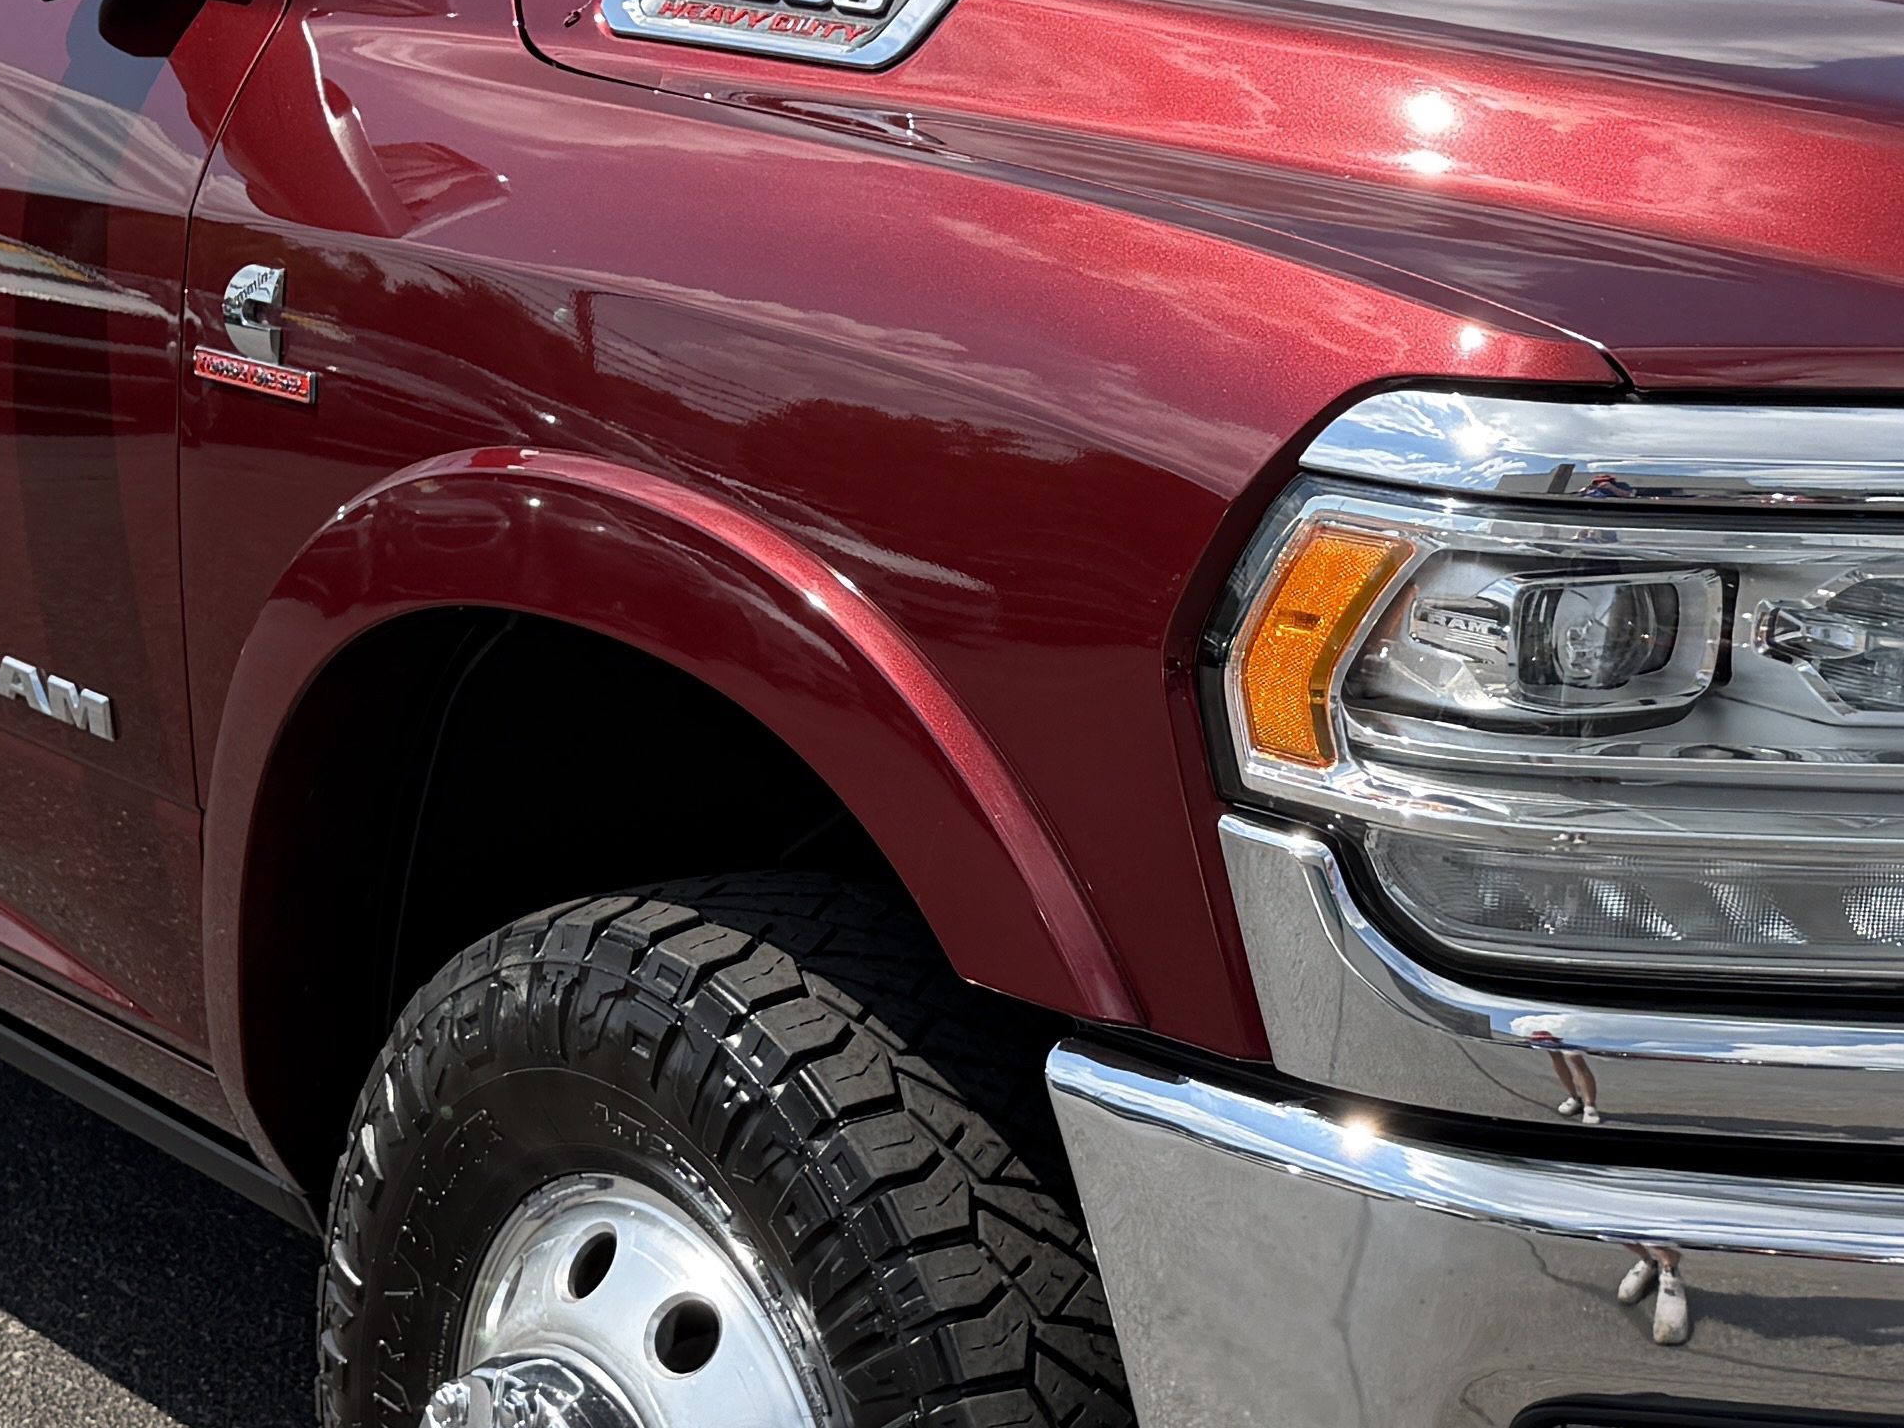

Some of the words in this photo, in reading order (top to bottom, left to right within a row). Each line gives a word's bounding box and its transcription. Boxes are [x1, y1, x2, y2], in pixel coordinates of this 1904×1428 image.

[657, 0, 770, 30] HEAVY
[767, 13, 875, 44] DUTY
[1427, 613, 1489, 634] RAM
